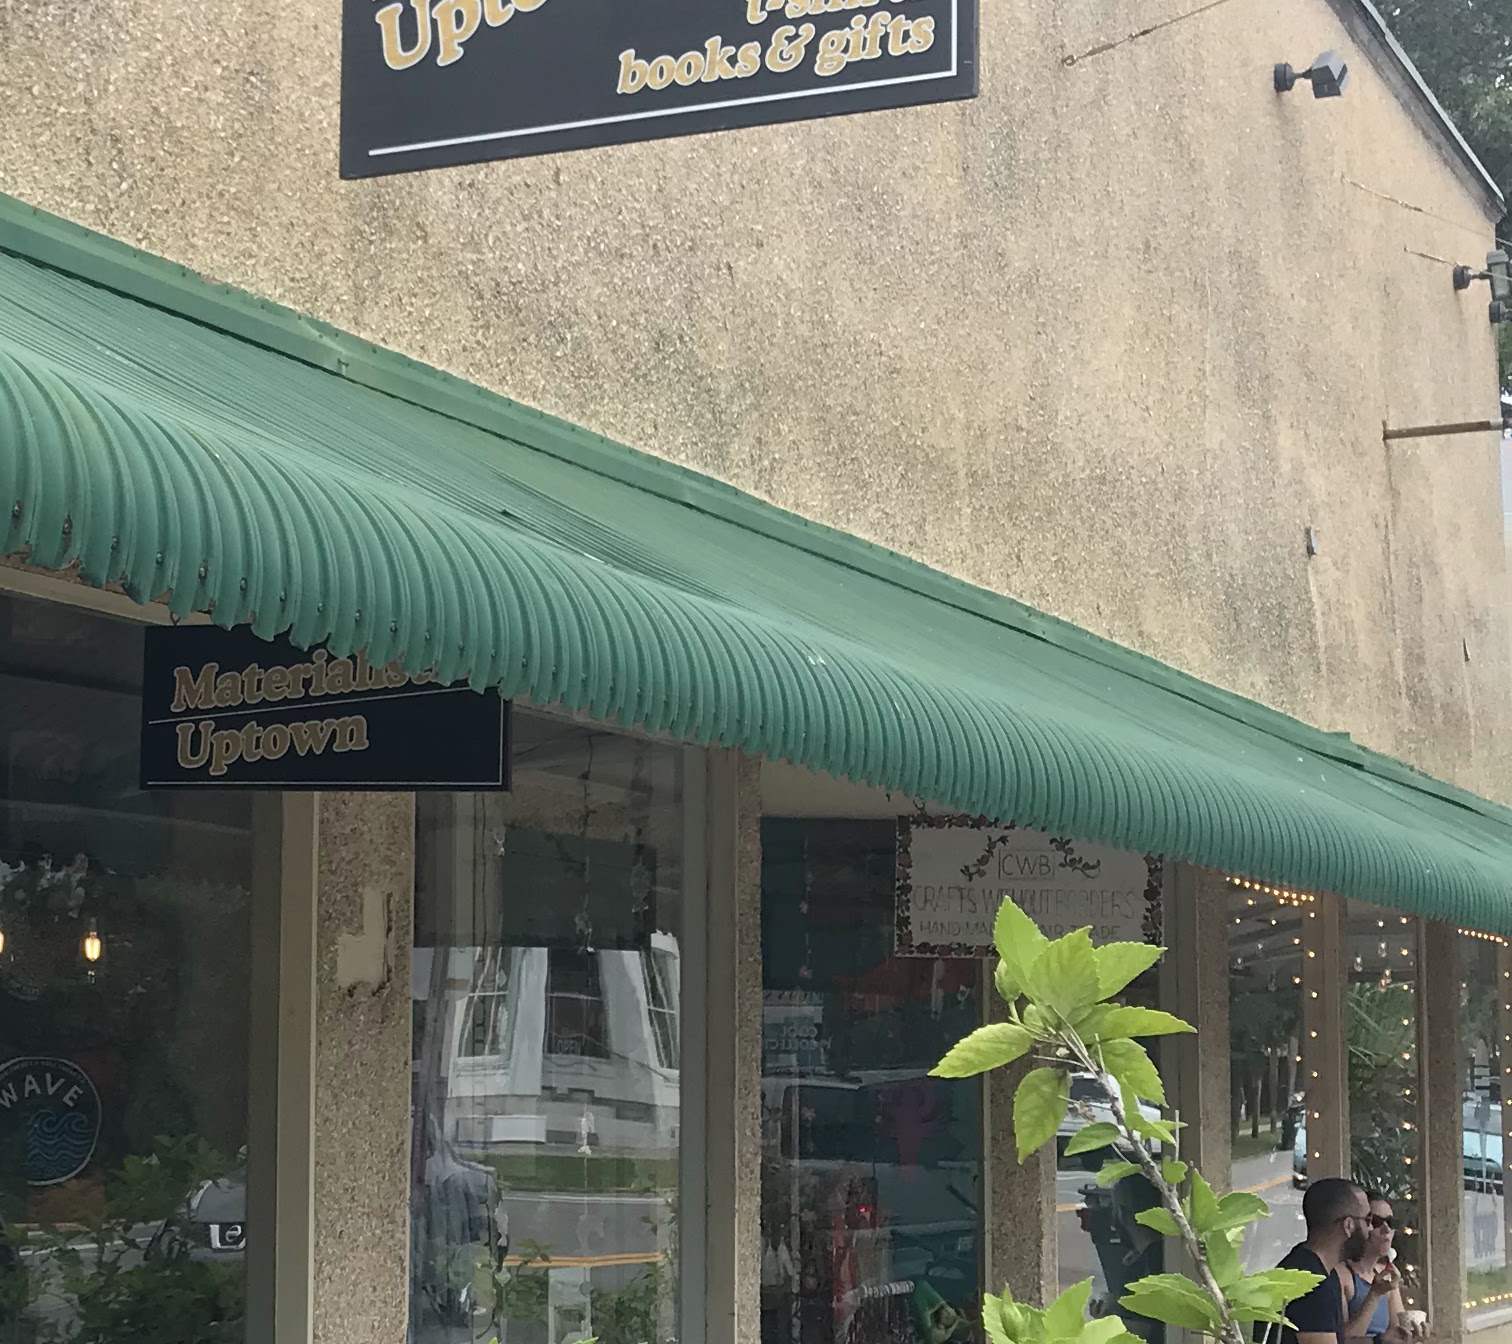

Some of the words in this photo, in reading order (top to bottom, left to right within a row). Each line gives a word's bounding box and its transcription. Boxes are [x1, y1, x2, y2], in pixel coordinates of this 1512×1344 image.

[616, 35, 761, 94] books
[764, 29, 814, 74] &
[814, 11, 935, 77] gifts
[176, 714, 370, 776] Uptown
[1001, 854, 1051, 878] CWB
[914, 885, 977, 914] CRAFTS
